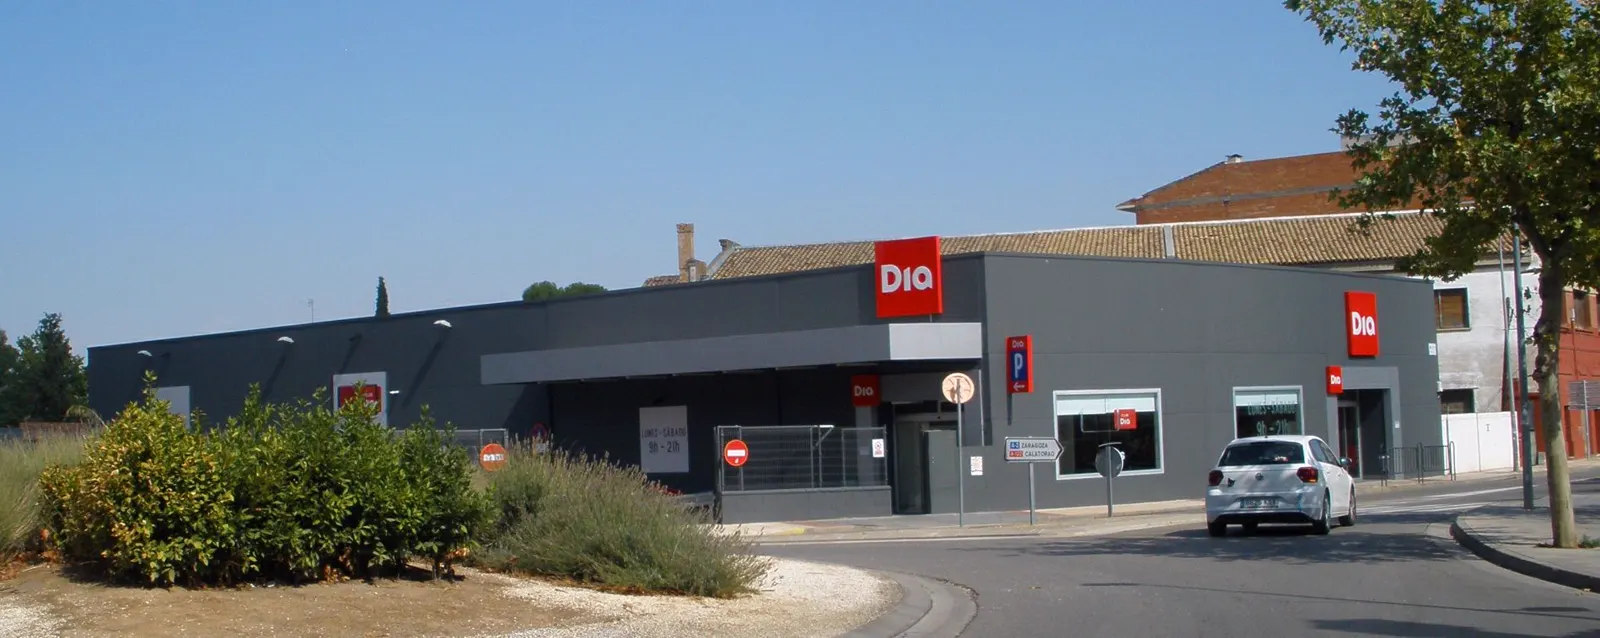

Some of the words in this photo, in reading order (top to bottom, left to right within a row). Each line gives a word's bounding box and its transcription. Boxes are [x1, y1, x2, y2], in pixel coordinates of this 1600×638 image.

[881, 264, 933, 293] Dia
[1351, 311, 1376, 336] Dia
[1014, 353, 1023, 379] P
[1330, 374, 1341, 384] Dia
[854, 385, 874, 396] Dia
[648, 441, 659, 454] 9h
[667, 440, 680, 453] 21h
